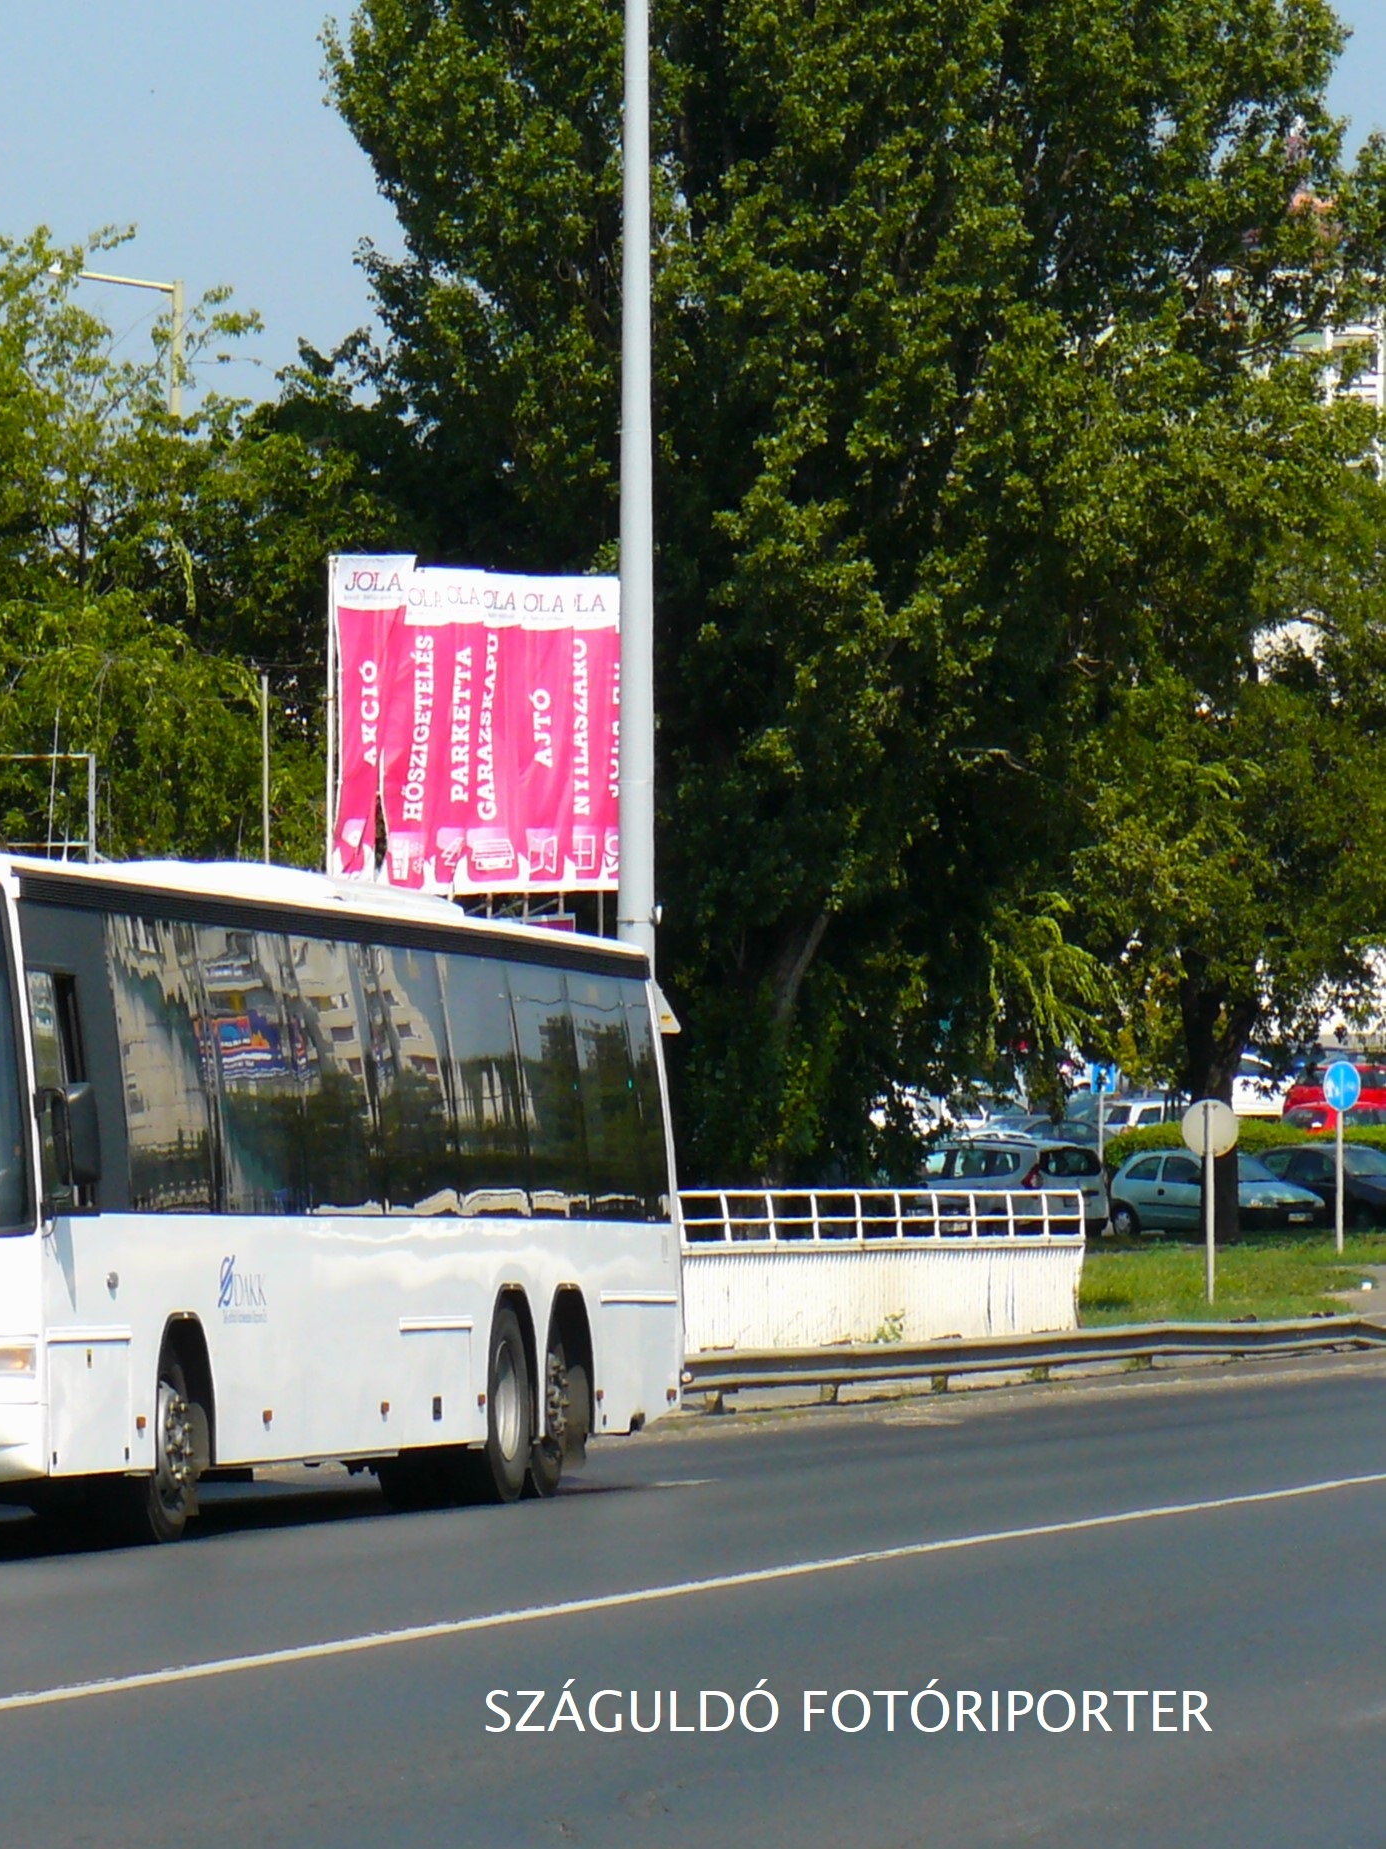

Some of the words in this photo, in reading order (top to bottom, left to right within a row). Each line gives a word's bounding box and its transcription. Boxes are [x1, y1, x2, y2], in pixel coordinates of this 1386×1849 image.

[344, 571, 403, 592] JOLA
[358, 660, 381, 767] AKCIÓ
[401, 635, 434, 822] HŐSZIGETELÉS
[450, 646, 473, 803] PARKETTA
[528, 688, 553, 769] AJTÓ
